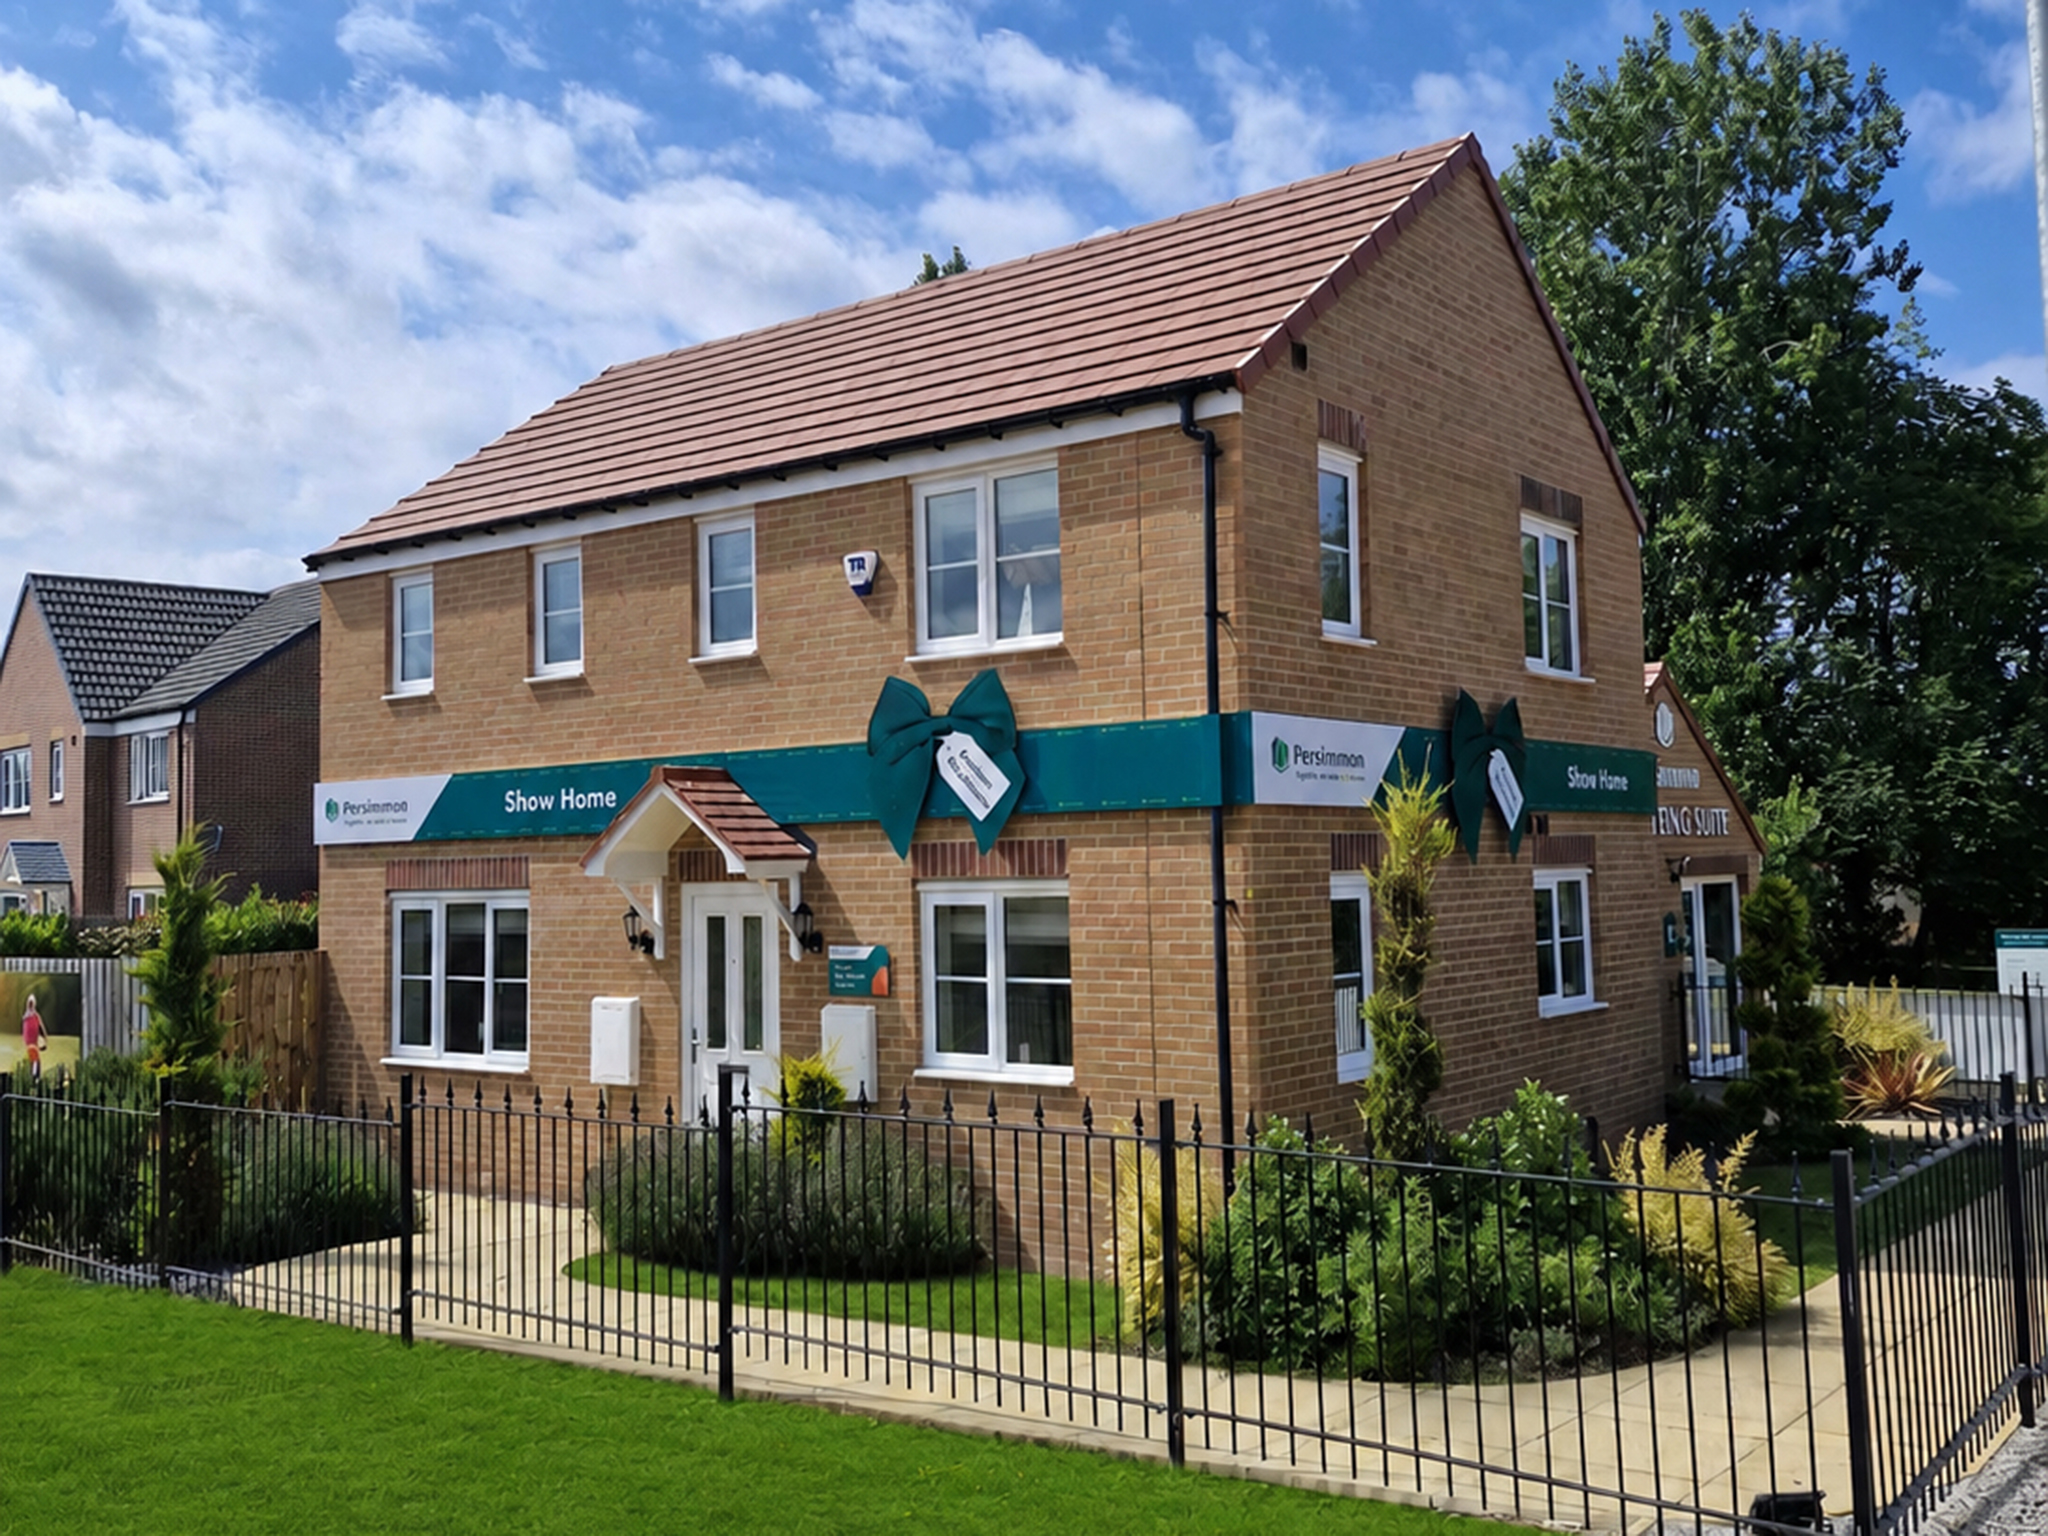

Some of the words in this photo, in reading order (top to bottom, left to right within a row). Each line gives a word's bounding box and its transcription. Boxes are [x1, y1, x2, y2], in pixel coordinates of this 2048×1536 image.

[1293, 744, 1365, 769] Persimmon
[1567, 764, 1597, 789] Show
[1598, 768, 1629, 791] Home
[343, 798, 408, 816] Persimmon
[504, 789, 555, 813] Show
[560, 787, 617, 810] Home
[1694, 806, 1730, 836] SUITE
